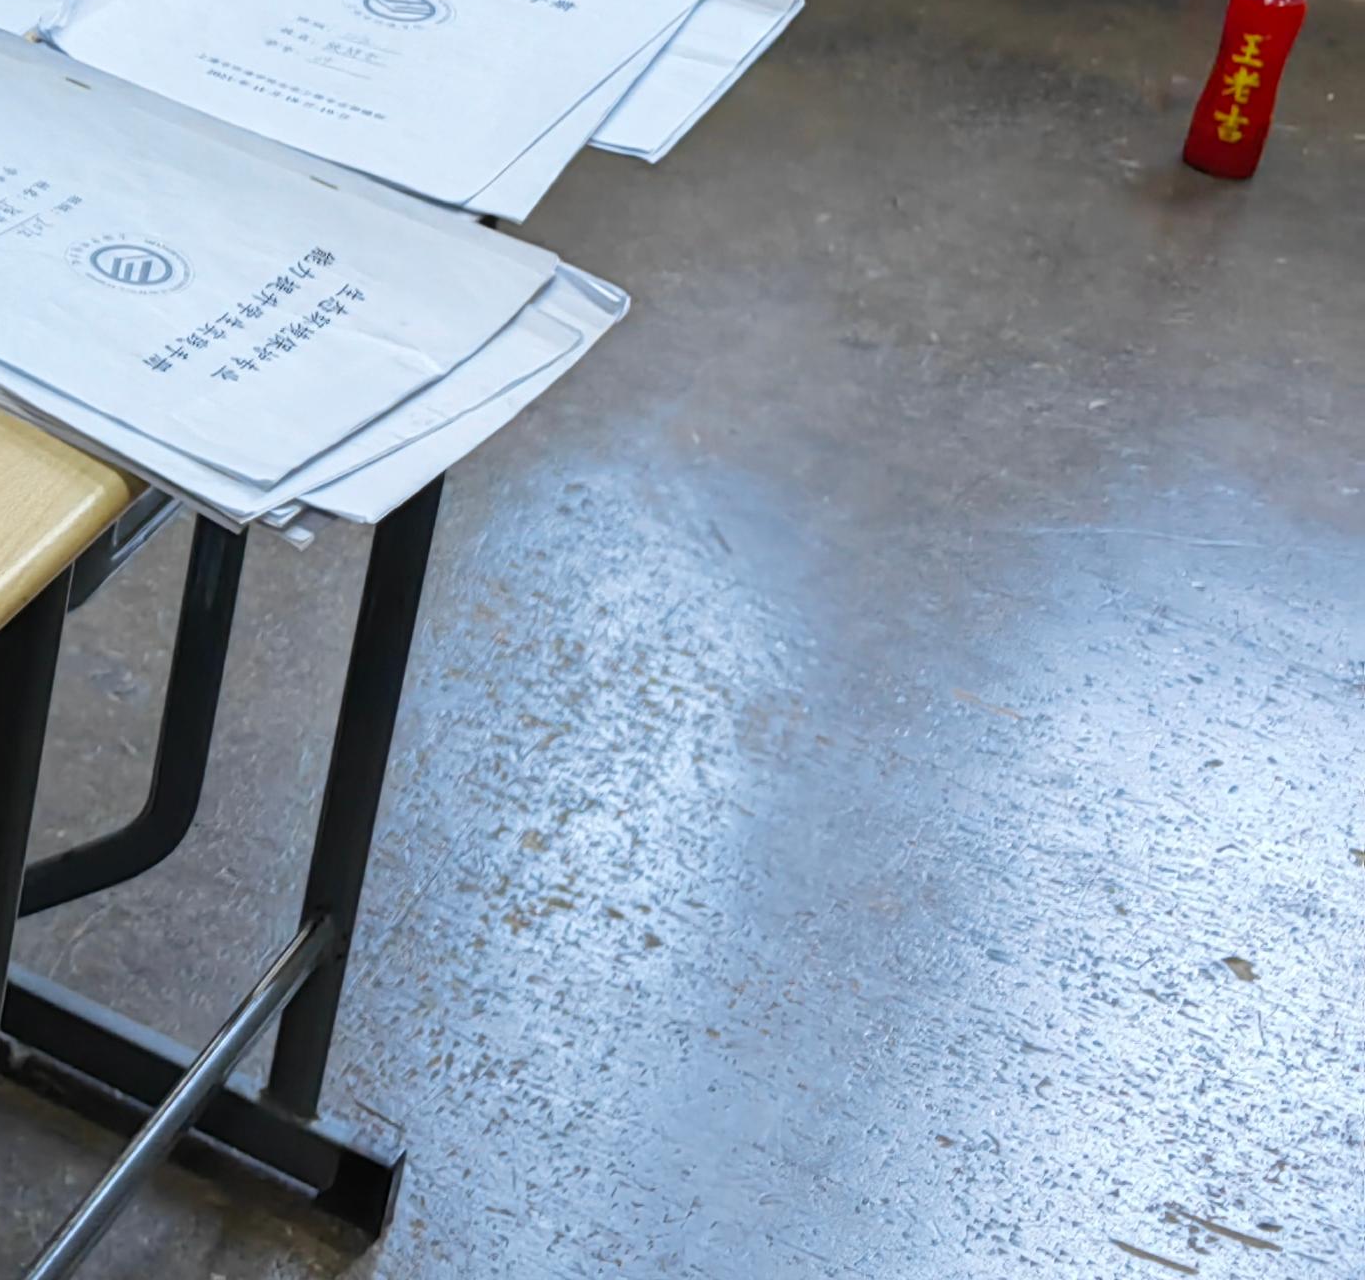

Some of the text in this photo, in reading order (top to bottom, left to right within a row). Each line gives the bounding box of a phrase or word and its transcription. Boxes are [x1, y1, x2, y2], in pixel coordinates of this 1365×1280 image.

[1213, 32, 1264, 144] 王老吉
[142, 247, 335, 372] 能力提升学生实践手册
[211, 283, 365, 381] 生态环境保护专业
